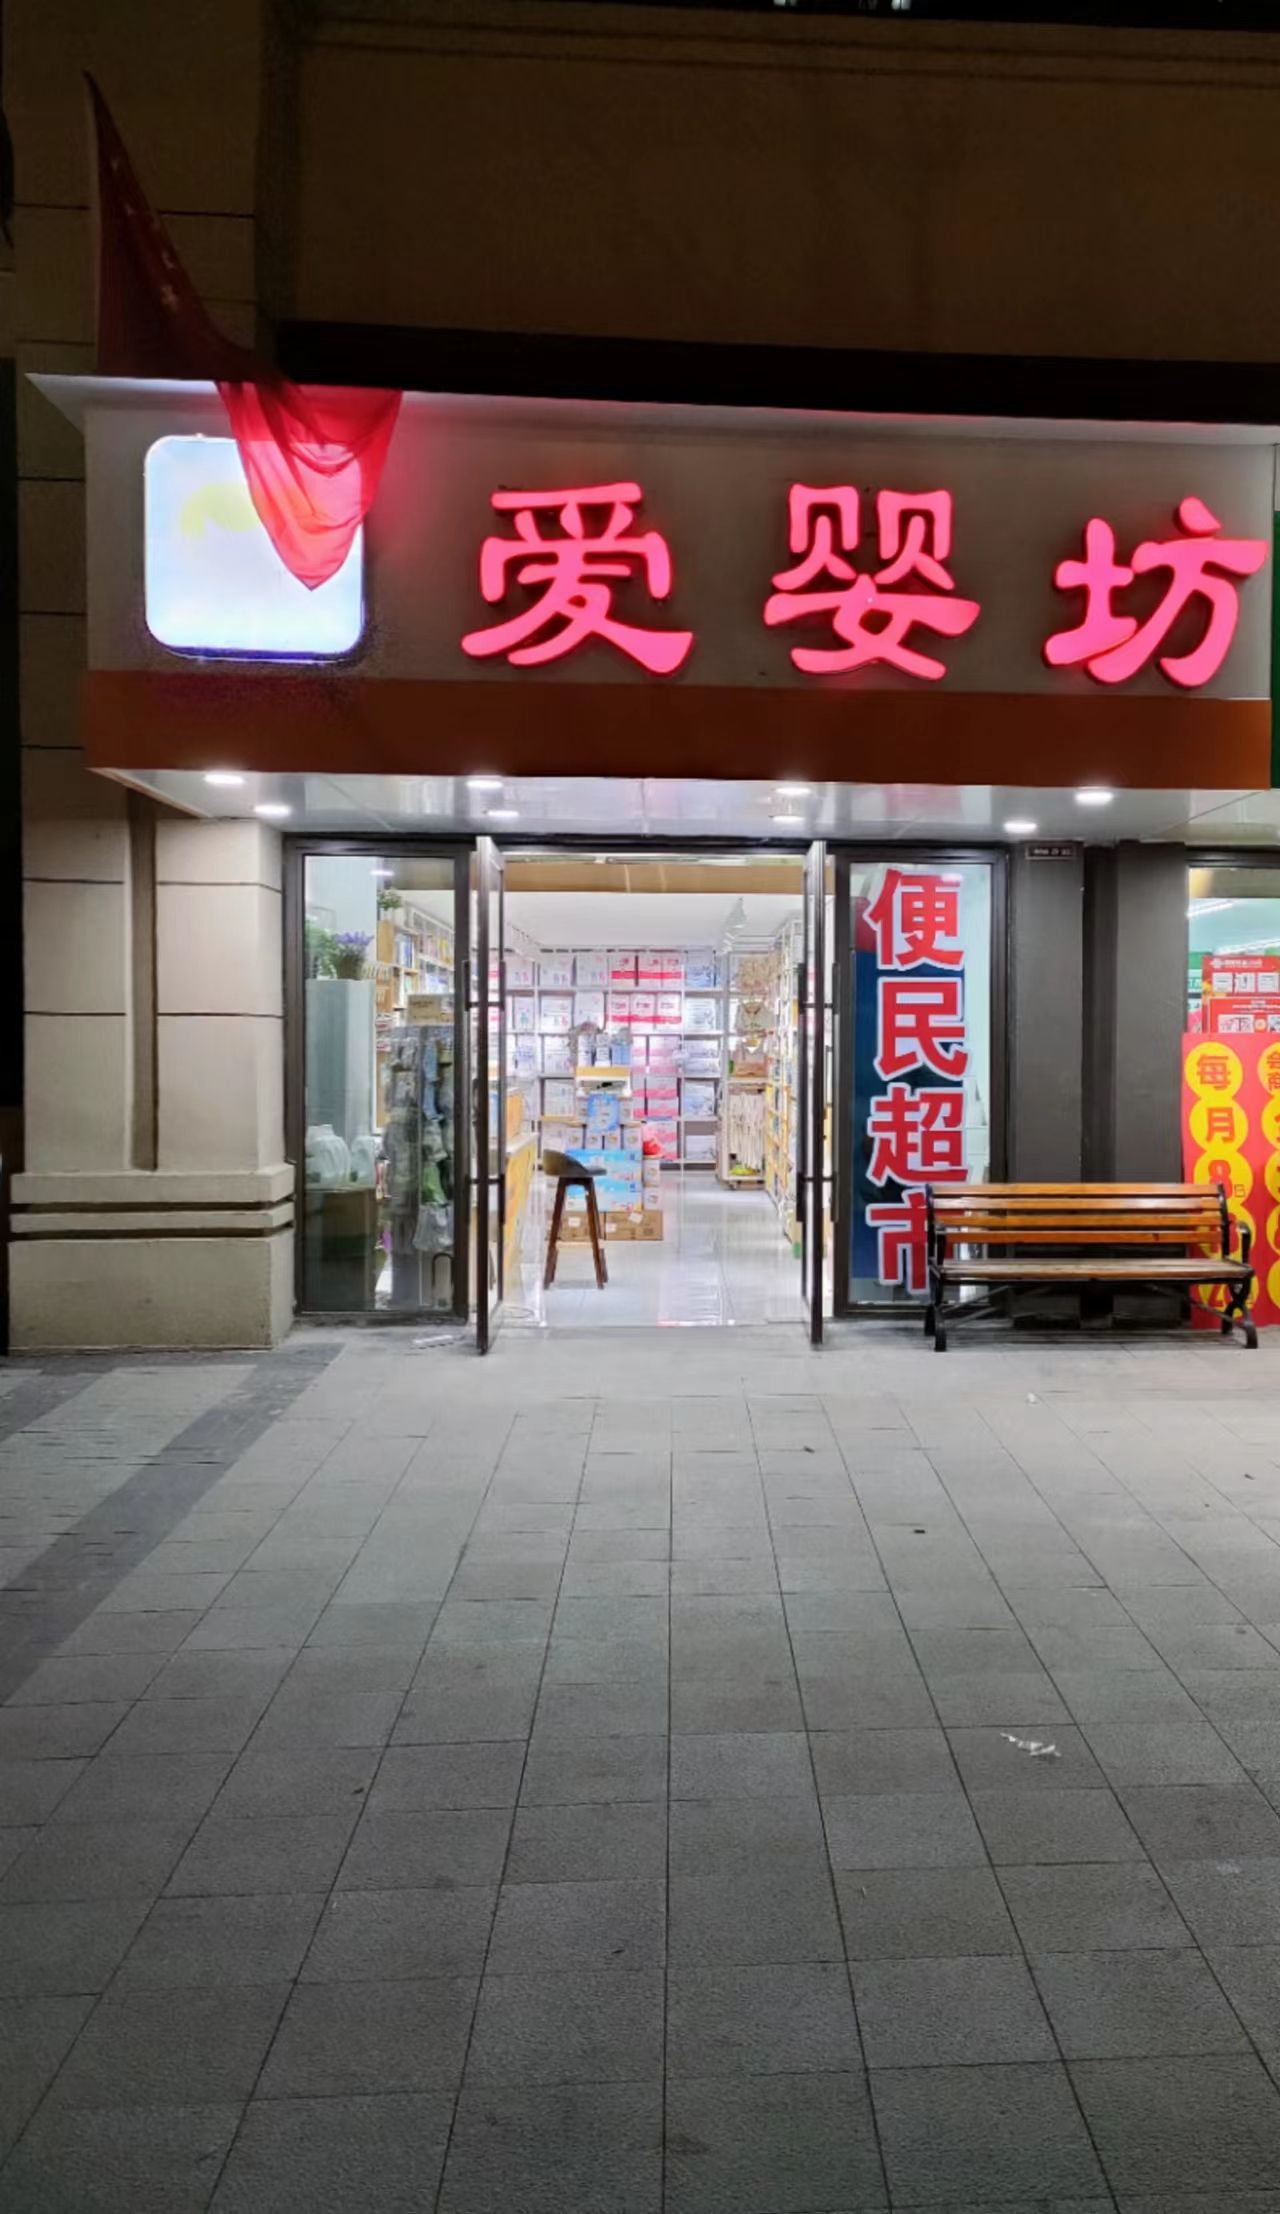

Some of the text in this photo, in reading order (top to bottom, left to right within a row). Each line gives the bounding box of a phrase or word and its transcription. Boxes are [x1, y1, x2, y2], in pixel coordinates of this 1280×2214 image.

[461, 482, 1271, 688] 爱婴坊
[866, 867, 969, 1292] 便民超市
